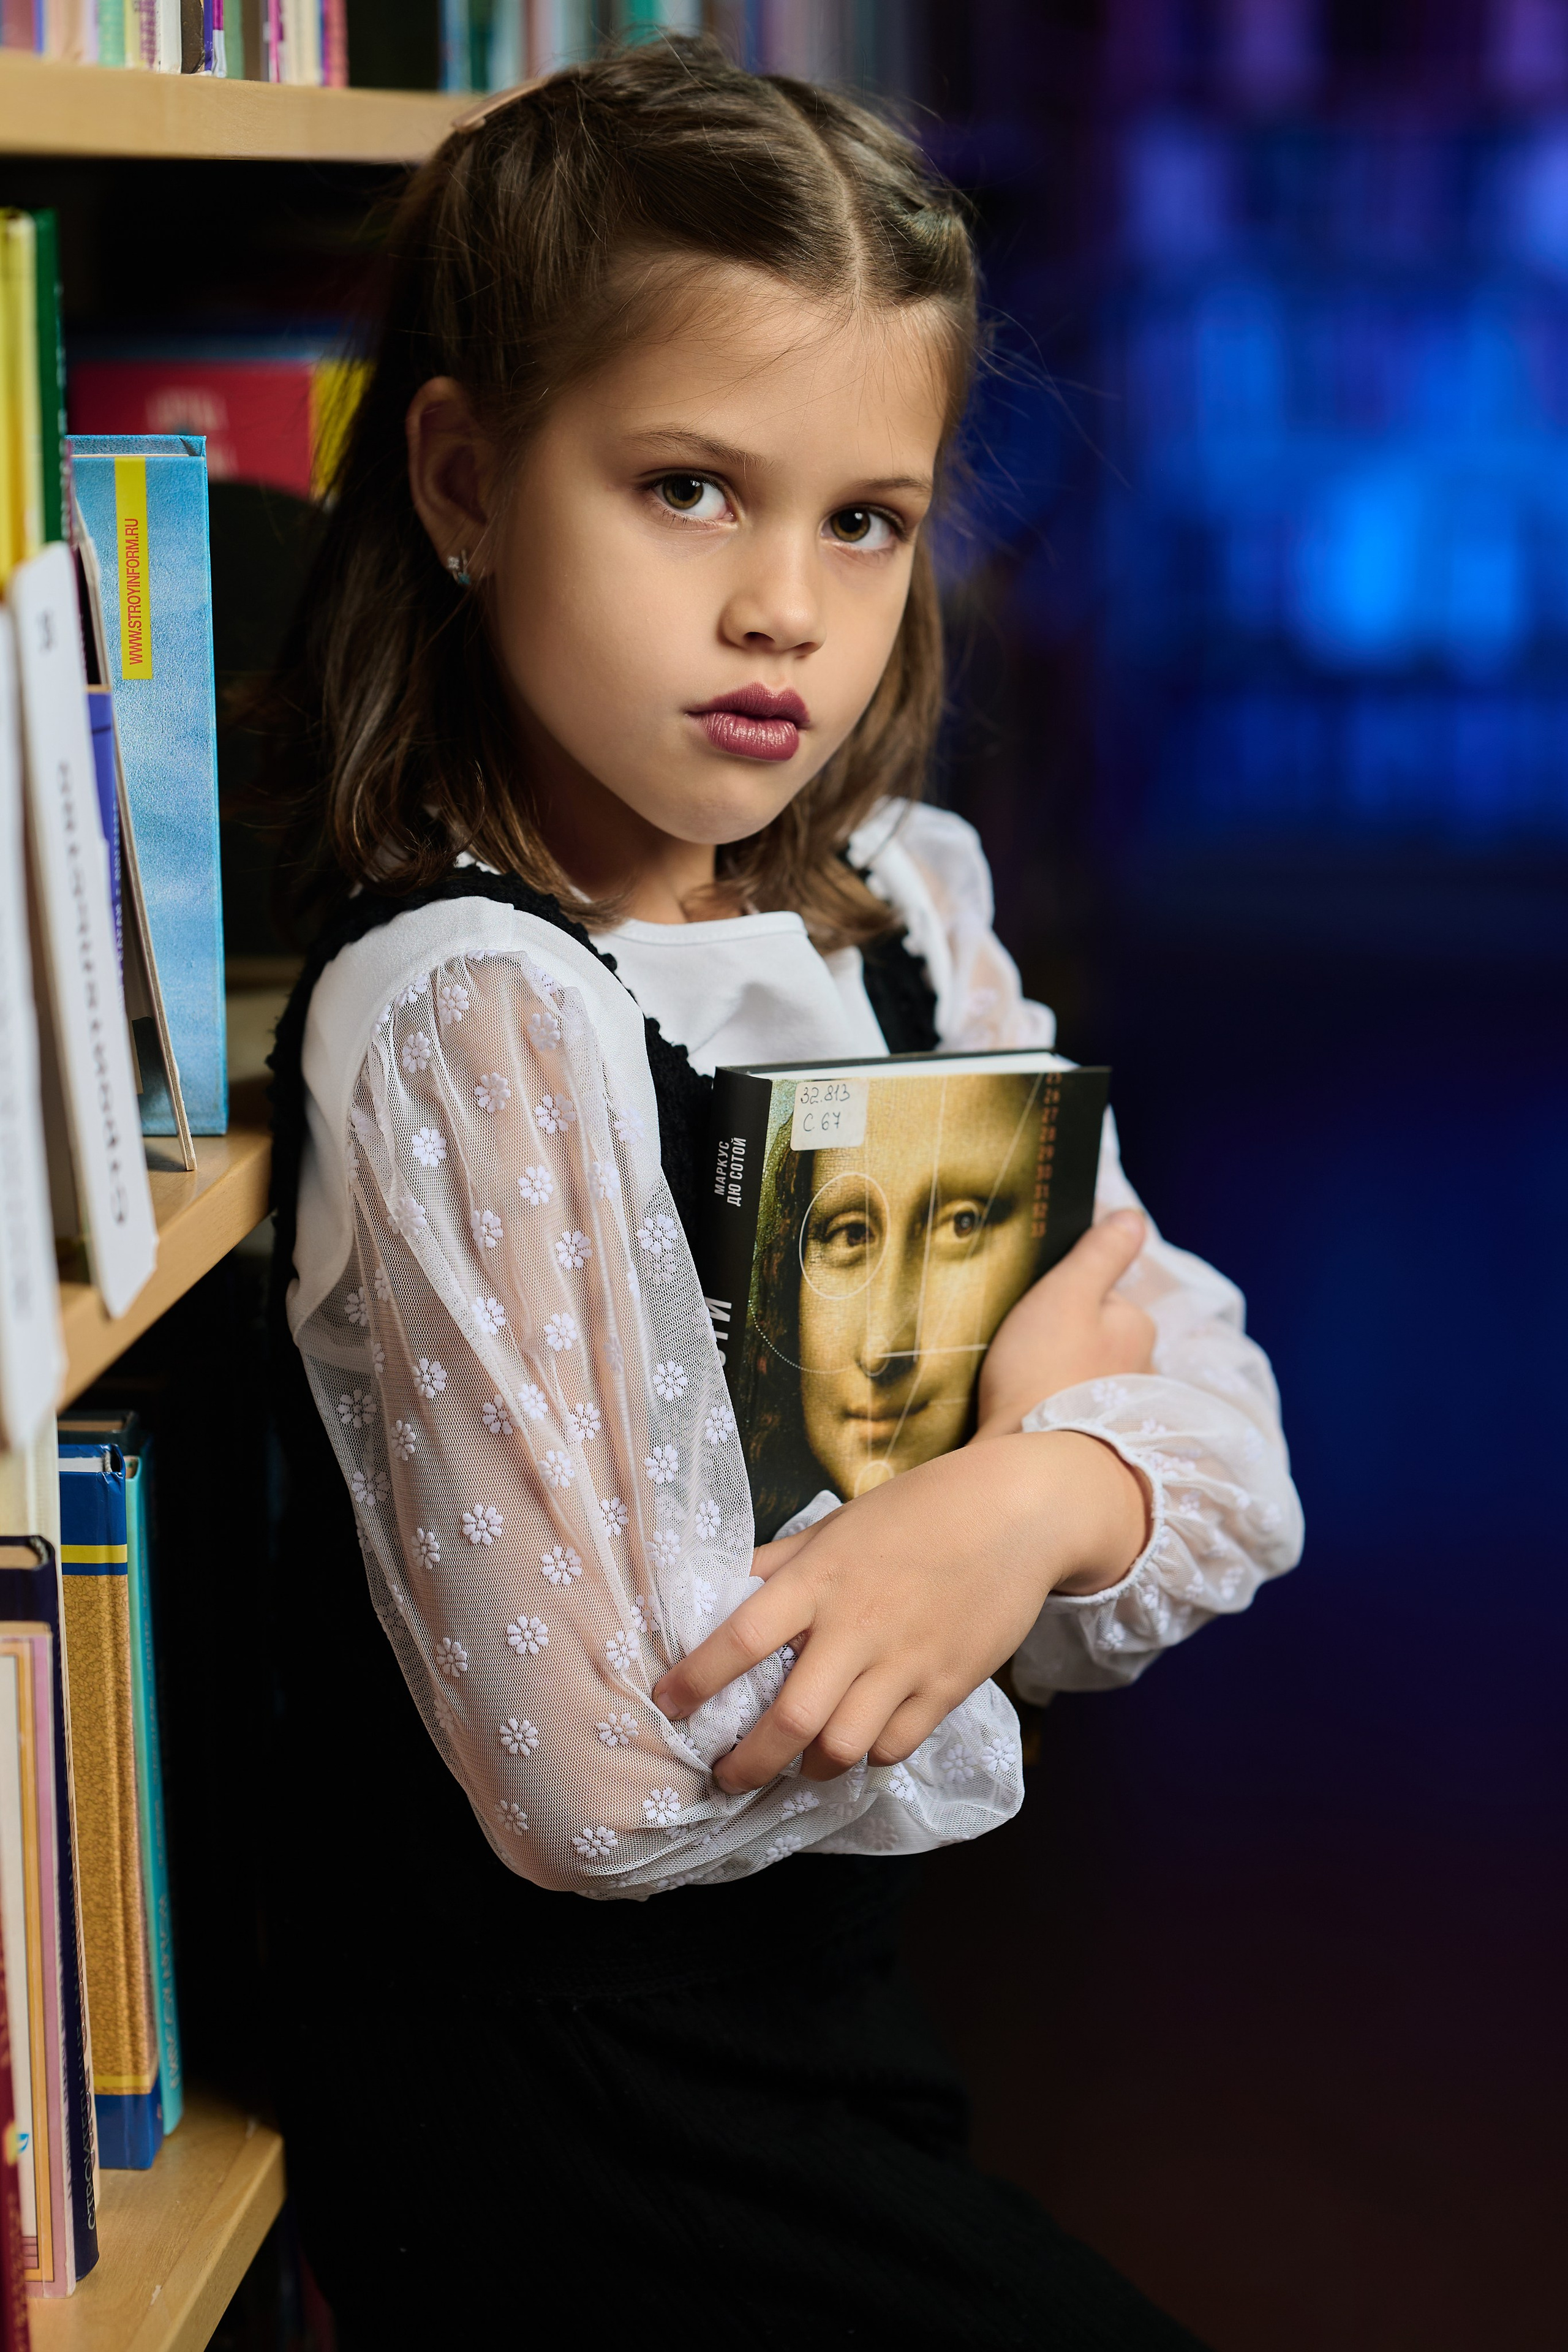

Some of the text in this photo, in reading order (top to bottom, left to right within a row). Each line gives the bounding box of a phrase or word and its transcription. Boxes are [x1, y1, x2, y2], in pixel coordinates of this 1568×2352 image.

[124, 518, 143, 665] WWW.STROYINFORM.RU
[800, 1084, 851, 1104] 32.813
[714, 1140, 729, 1196] МАРКУС
[726, 1137, 747, 1207] ДЮ СОТОЙ
